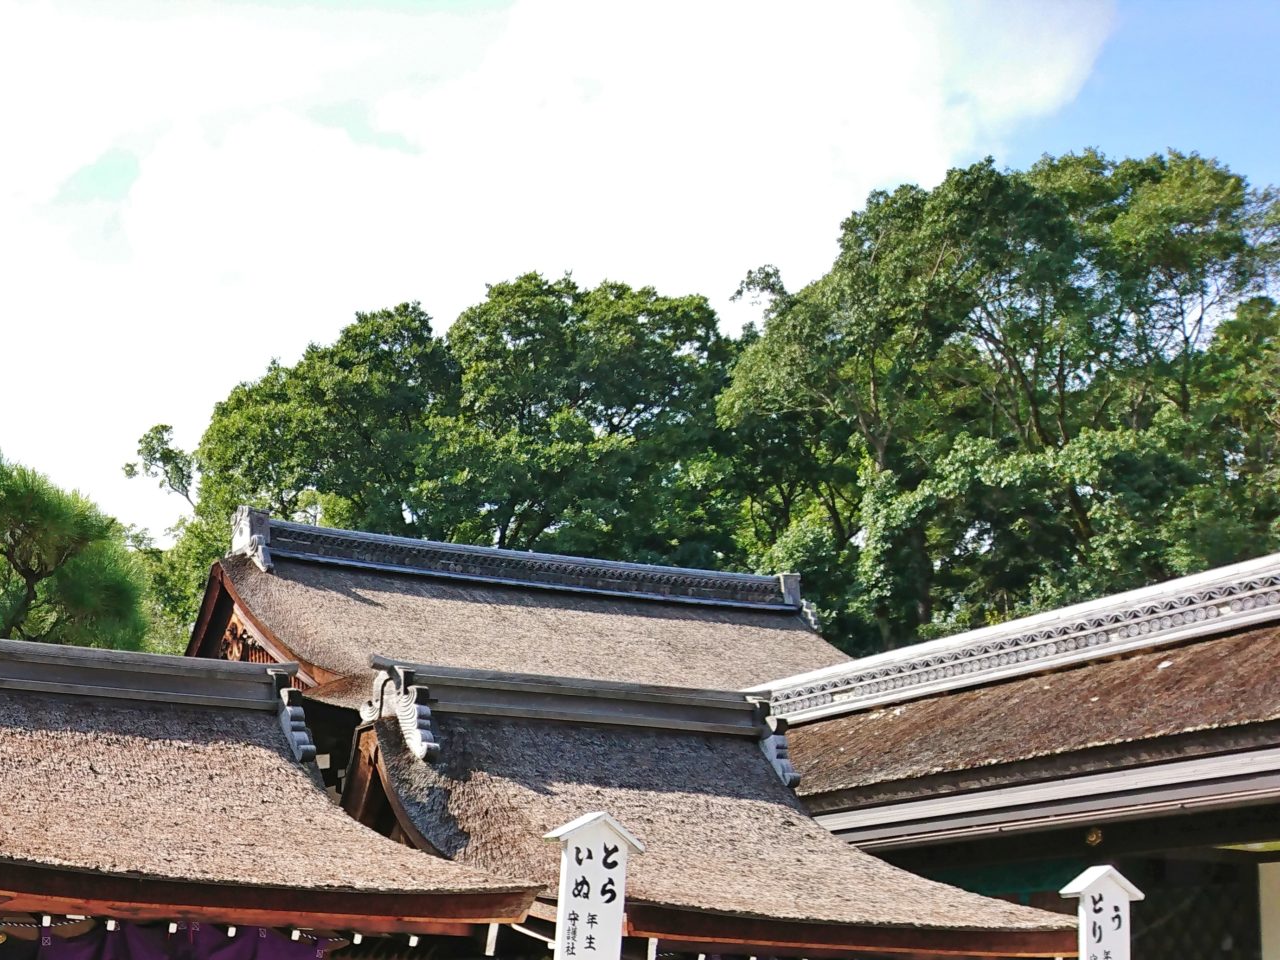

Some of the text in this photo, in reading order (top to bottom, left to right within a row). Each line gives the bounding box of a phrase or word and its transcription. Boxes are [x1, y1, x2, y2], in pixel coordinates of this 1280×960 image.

[572, 846, 593, 900] いぬ
[600, 841, 619, 904] とら
[565, 910, 580, 956] 守護社
[584, 912, 598, 951] 年生
[1090, 892, 1104, 944] とり
[1111, 905, 1122, 931] う
